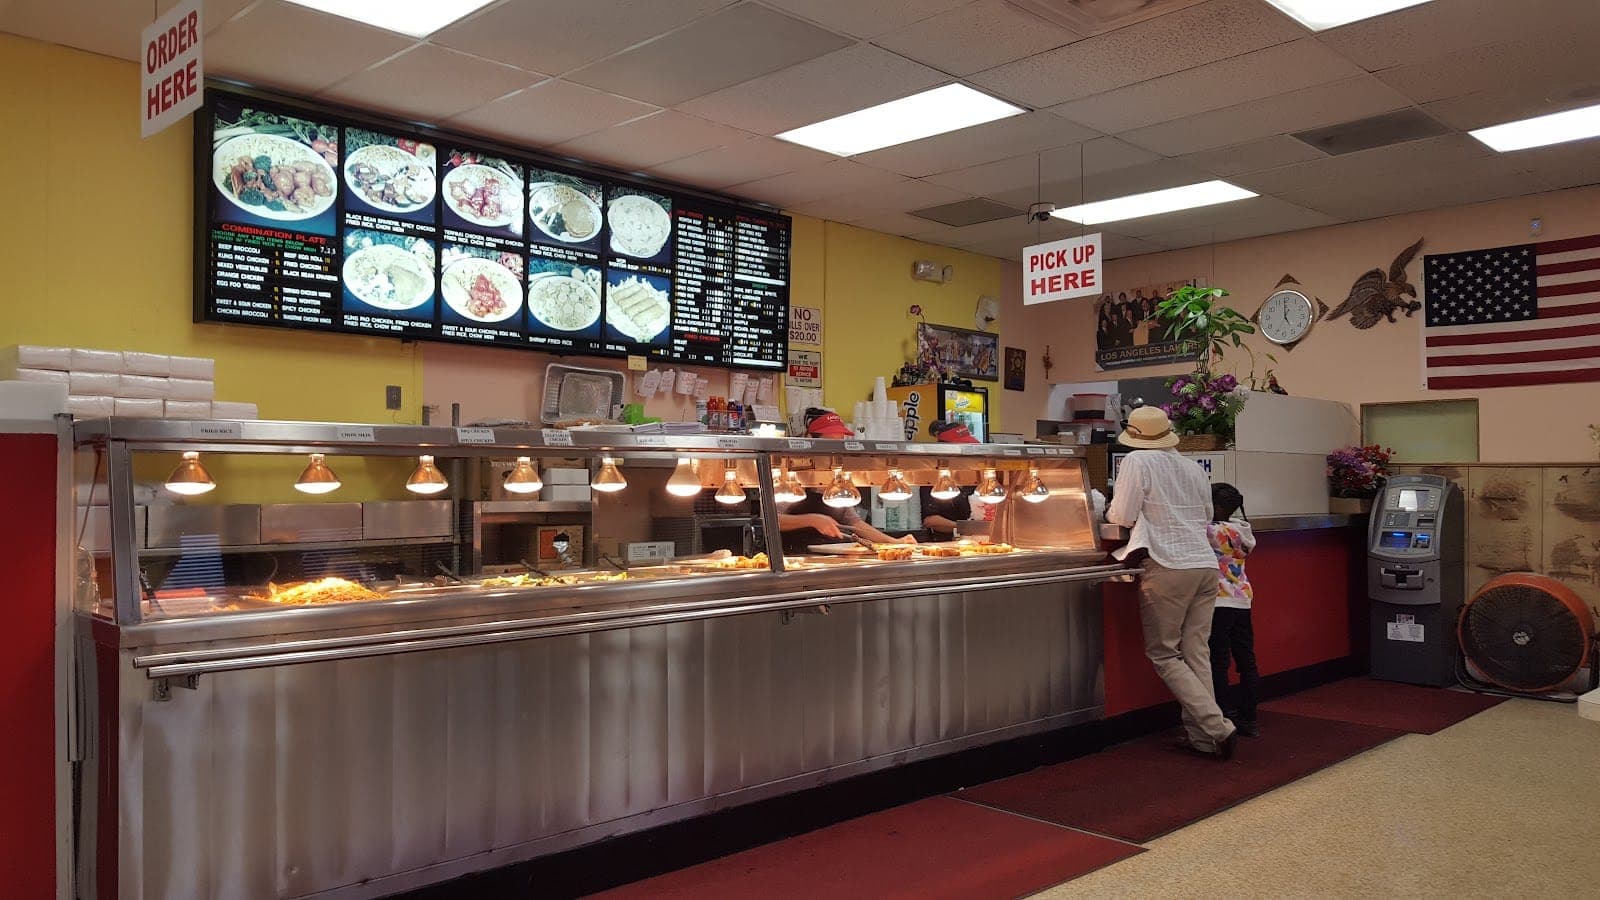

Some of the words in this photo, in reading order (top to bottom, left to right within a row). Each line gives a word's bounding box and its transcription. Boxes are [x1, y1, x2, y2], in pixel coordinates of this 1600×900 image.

[147, 10, 198, 75] ORDER
[147, 59, 197, 120] HERE
[223, 224, 292, 239] COMBINATION
[296, 234, 327, 245] PLATE
[1030, 250, 1067, 272] PICK
[1073, 244, 1095, 264] UP
[1031, 269, 1096, 296] HERE
[794, 308, 811, 320] NO
[790, 330, 816, 342] $20.00
[804, 322, 819, 332] OVER
[1101, 352, 1117, 360] LOS
[1120, 346, 1160, 358] ANGELES
[1164, 342, 1200, 353] LARS
[904, 392, 919, 440] apple
